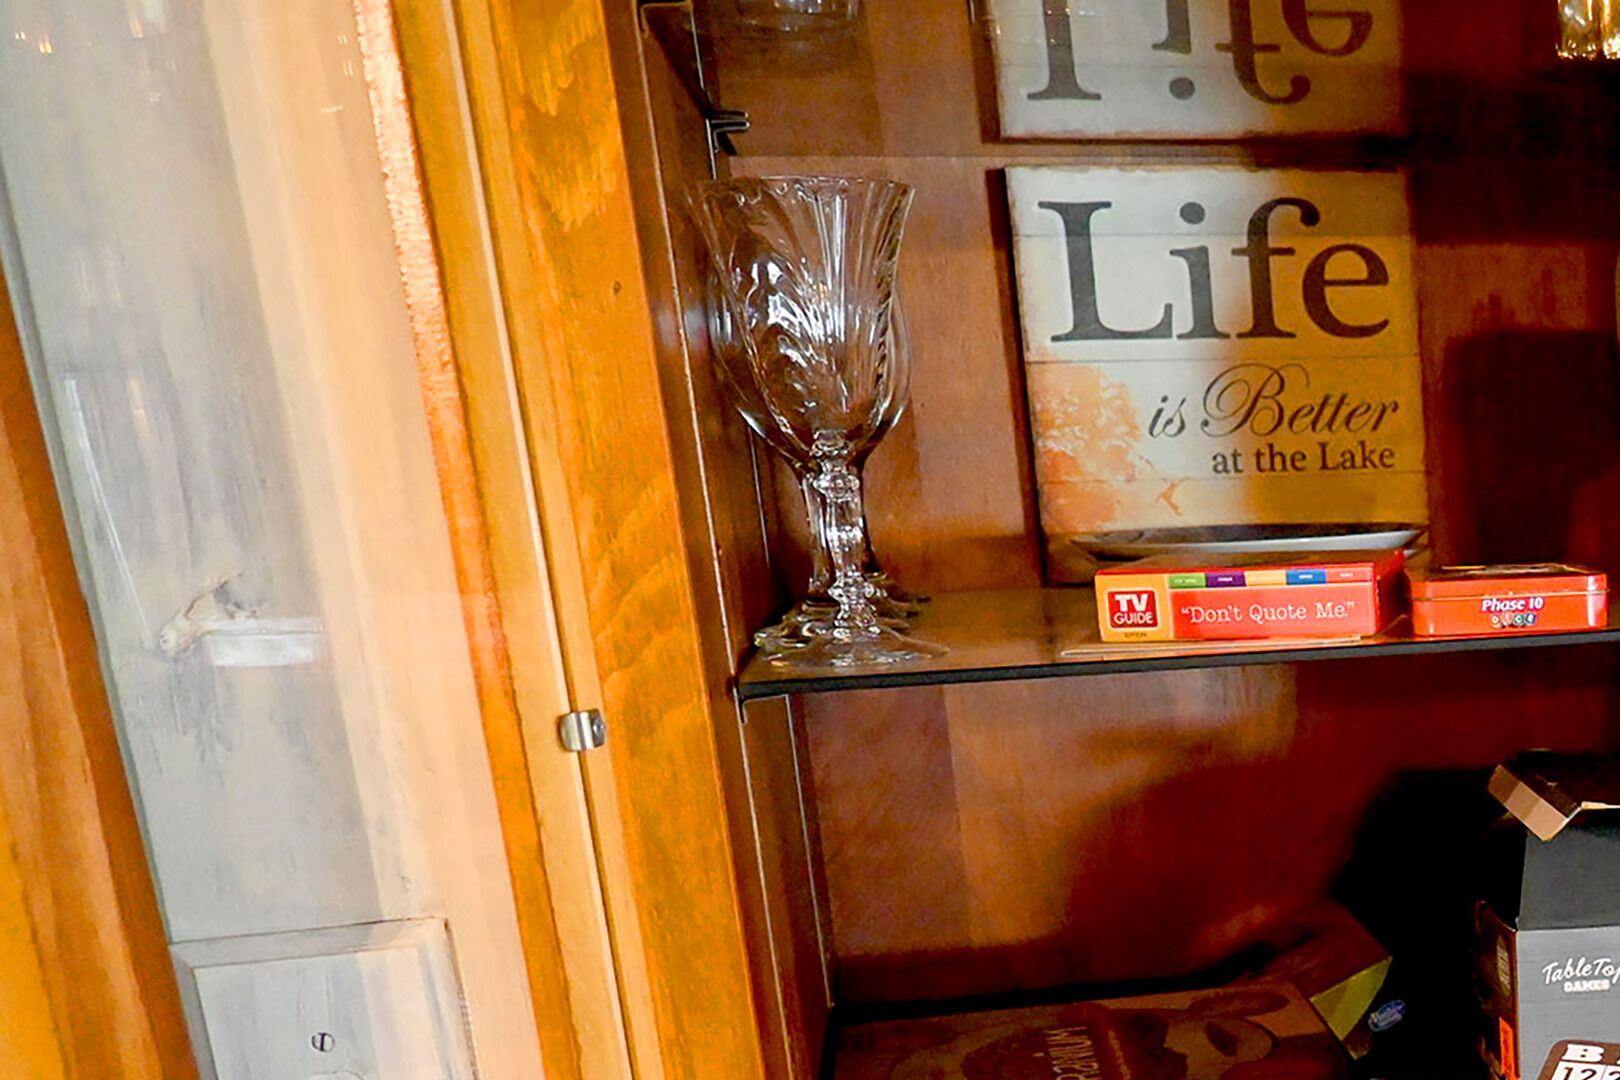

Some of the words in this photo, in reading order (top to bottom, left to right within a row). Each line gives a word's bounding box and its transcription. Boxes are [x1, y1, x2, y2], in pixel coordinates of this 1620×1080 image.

[1038, 197, 1389, 342] Life
[1147, 395, 1187, 439] is
[1200, 363, 1399, 438] Better
[1211, 447, 1243, 474] at
[1255, 443, 1307, 473] the
[1317, 440, 1395, 472] Lake
[1114, 593, 1149, 612] TV
[1481, 597, 1525, 612] Phase
[1529, 596, 1544, 610] 10
[1114, 611, 1154, 626] GUIDE
[1250, 603, 1307, 625] Quote
[1563, 979, 1611, 993] GAMES
